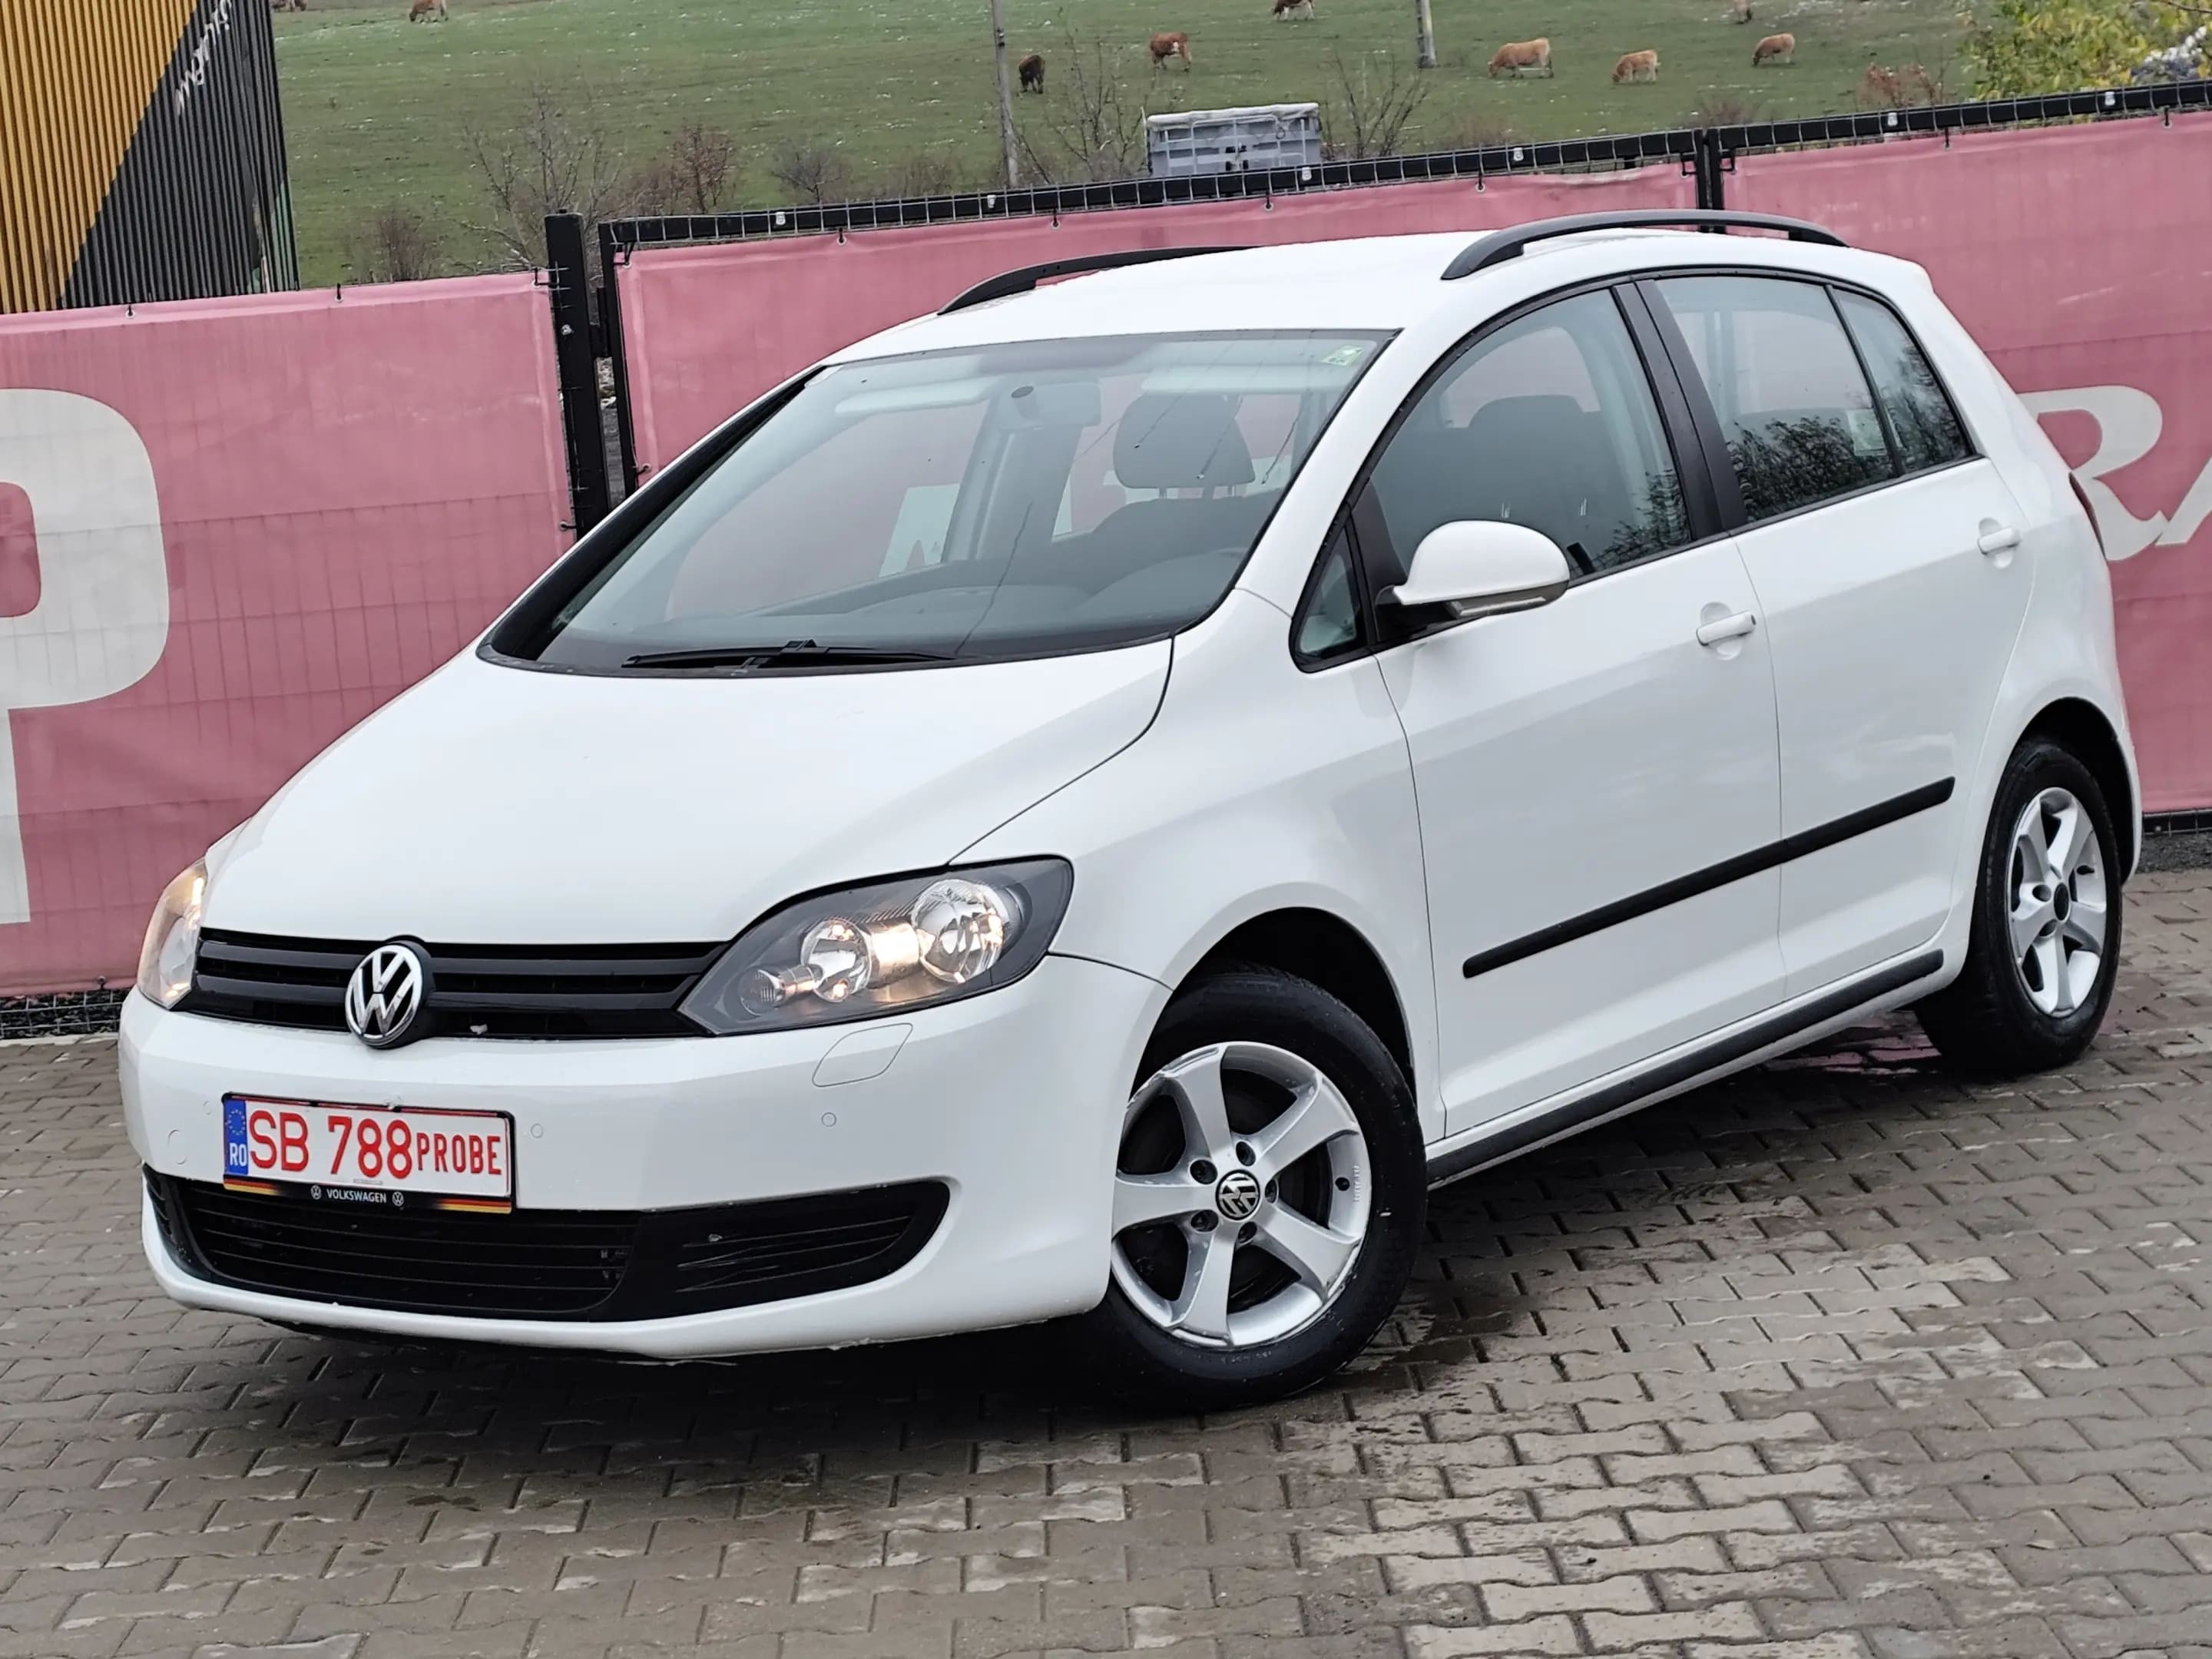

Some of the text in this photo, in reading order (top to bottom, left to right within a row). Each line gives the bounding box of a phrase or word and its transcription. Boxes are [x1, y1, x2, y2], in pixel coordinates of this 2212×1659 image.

[249, 1110, 309, 1172] SB
[230, 1143, 247, 1167] RO
[326, 1188, 387, 1204] VOLKSWAGEN
